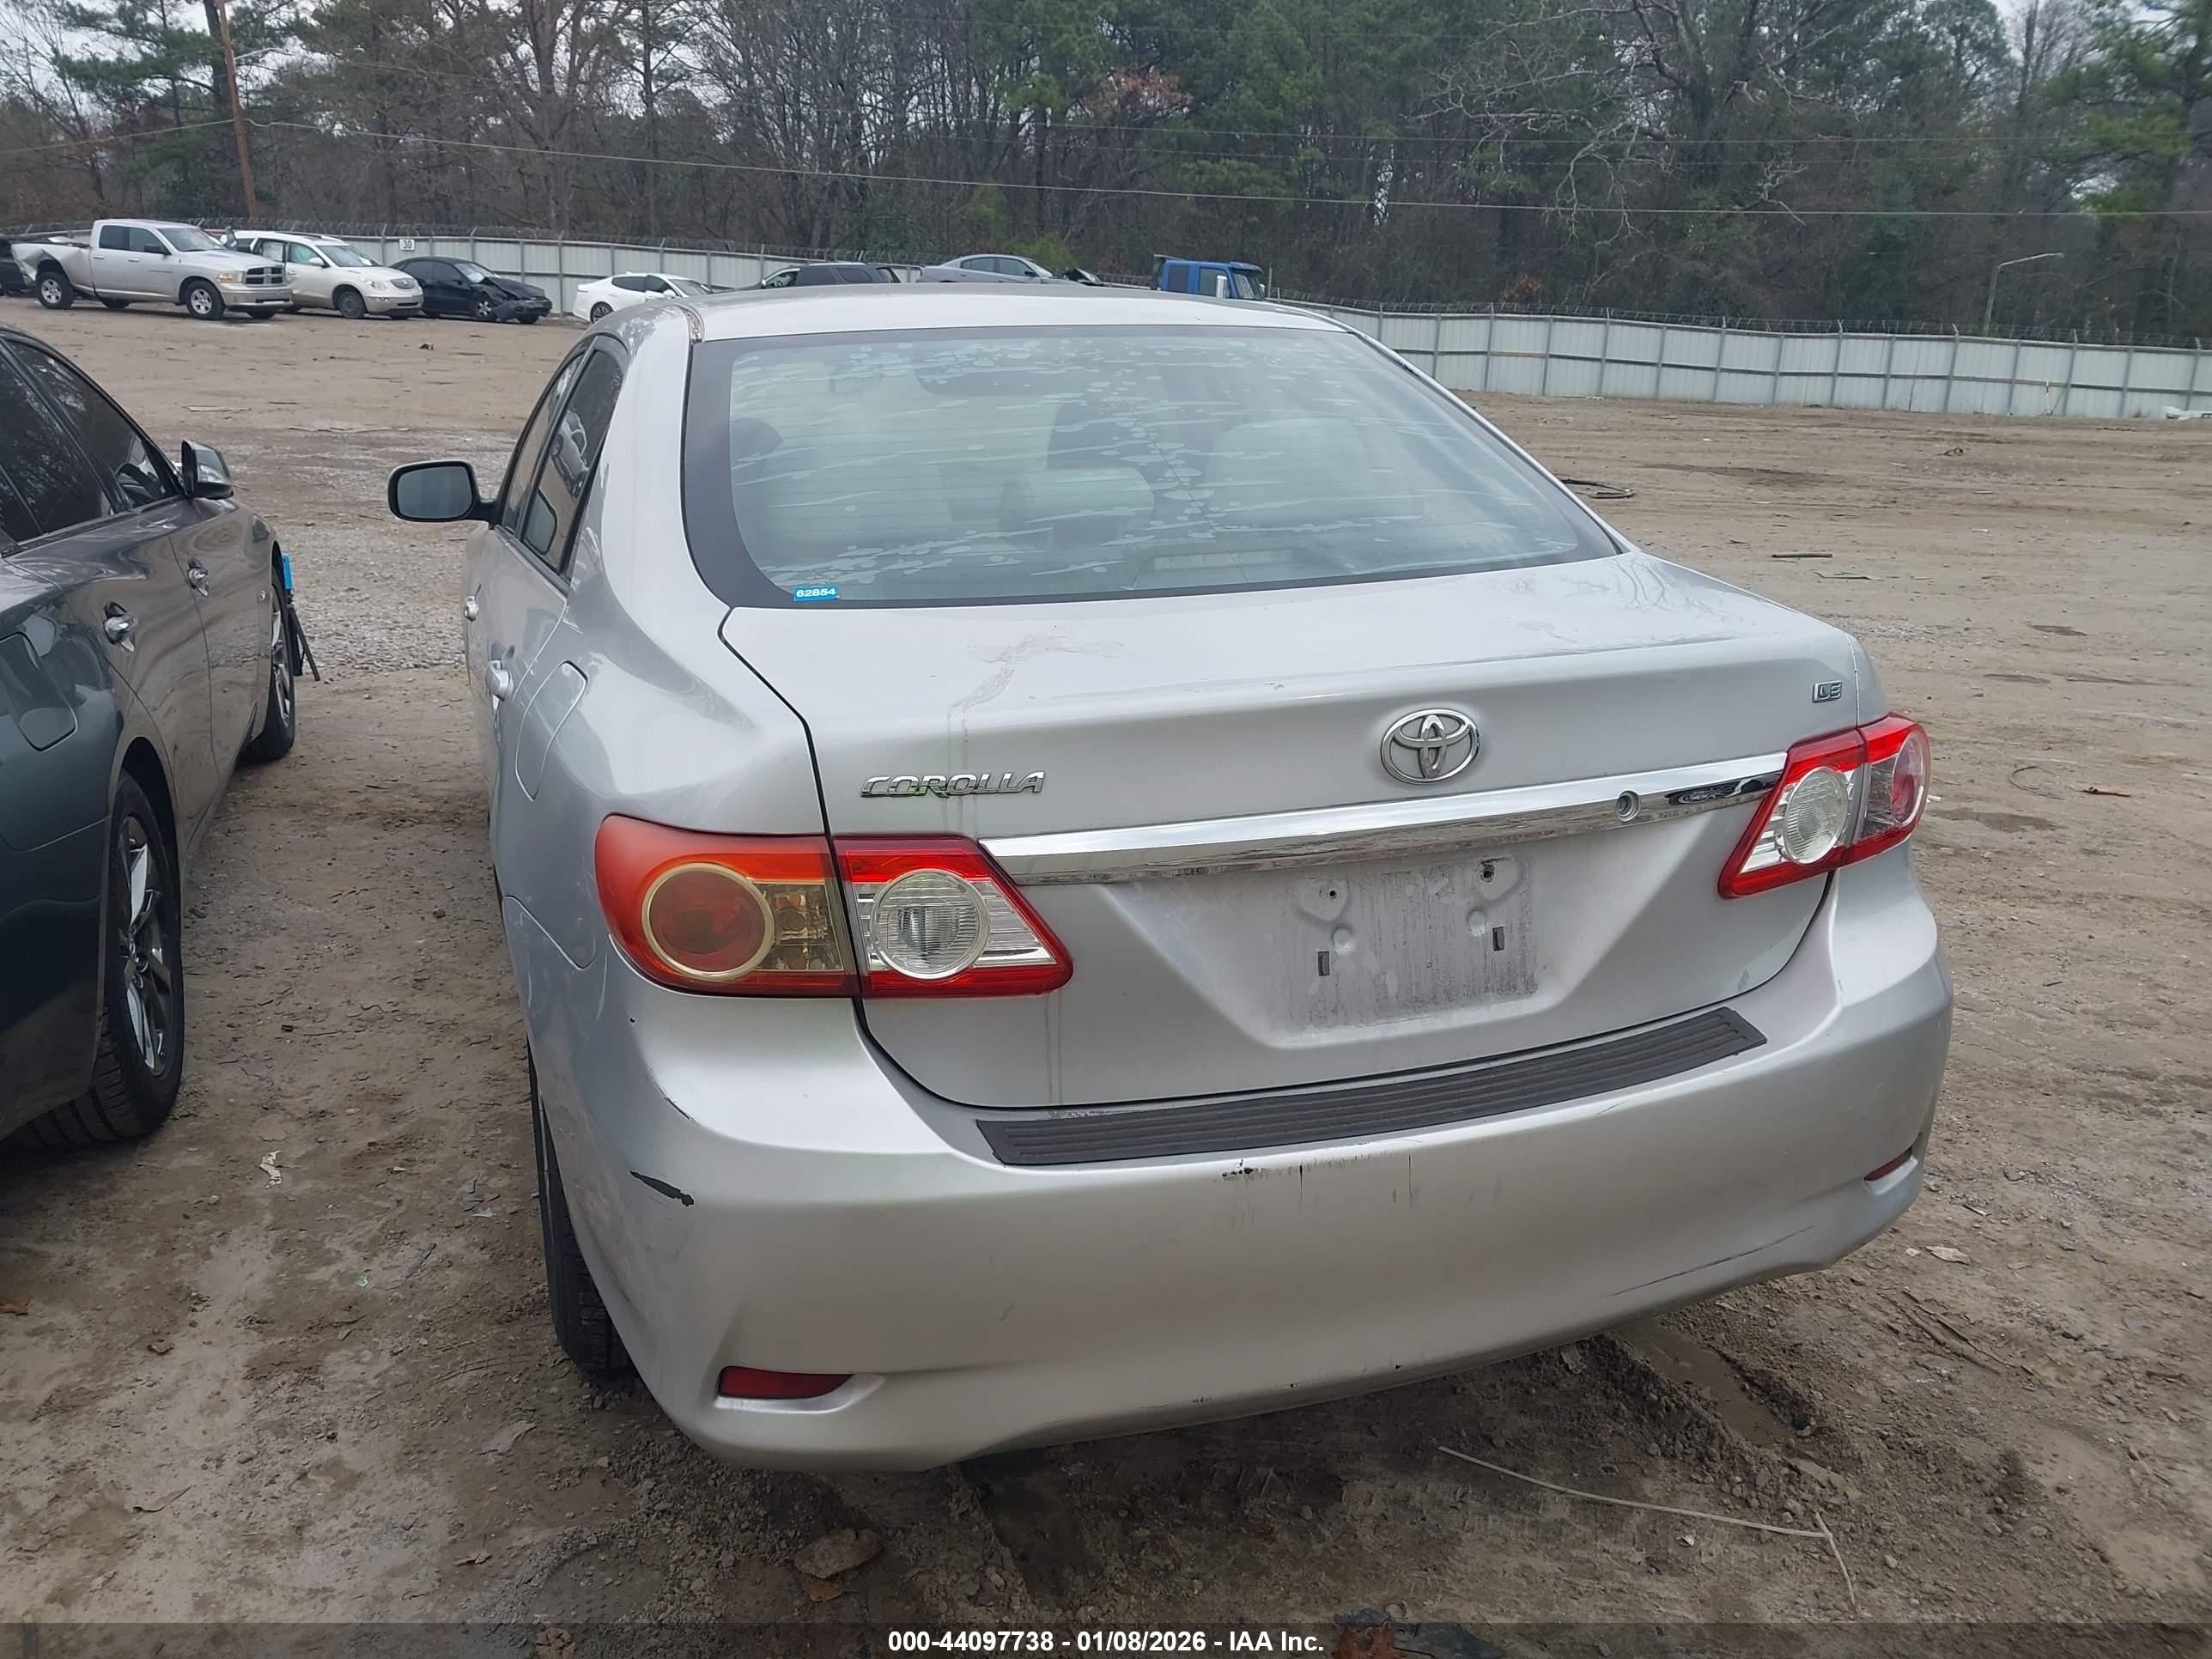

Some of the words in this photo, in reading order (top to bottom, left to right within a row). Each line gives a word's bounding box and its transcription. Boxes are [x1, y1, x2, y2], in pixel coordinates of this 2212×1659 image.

[403, 240, 412, 249] 30
[796, 587, 836, 598] 62854
[1813, 680, 1842, 703] LE
[860, 771, 1044, 799] COROLLA
